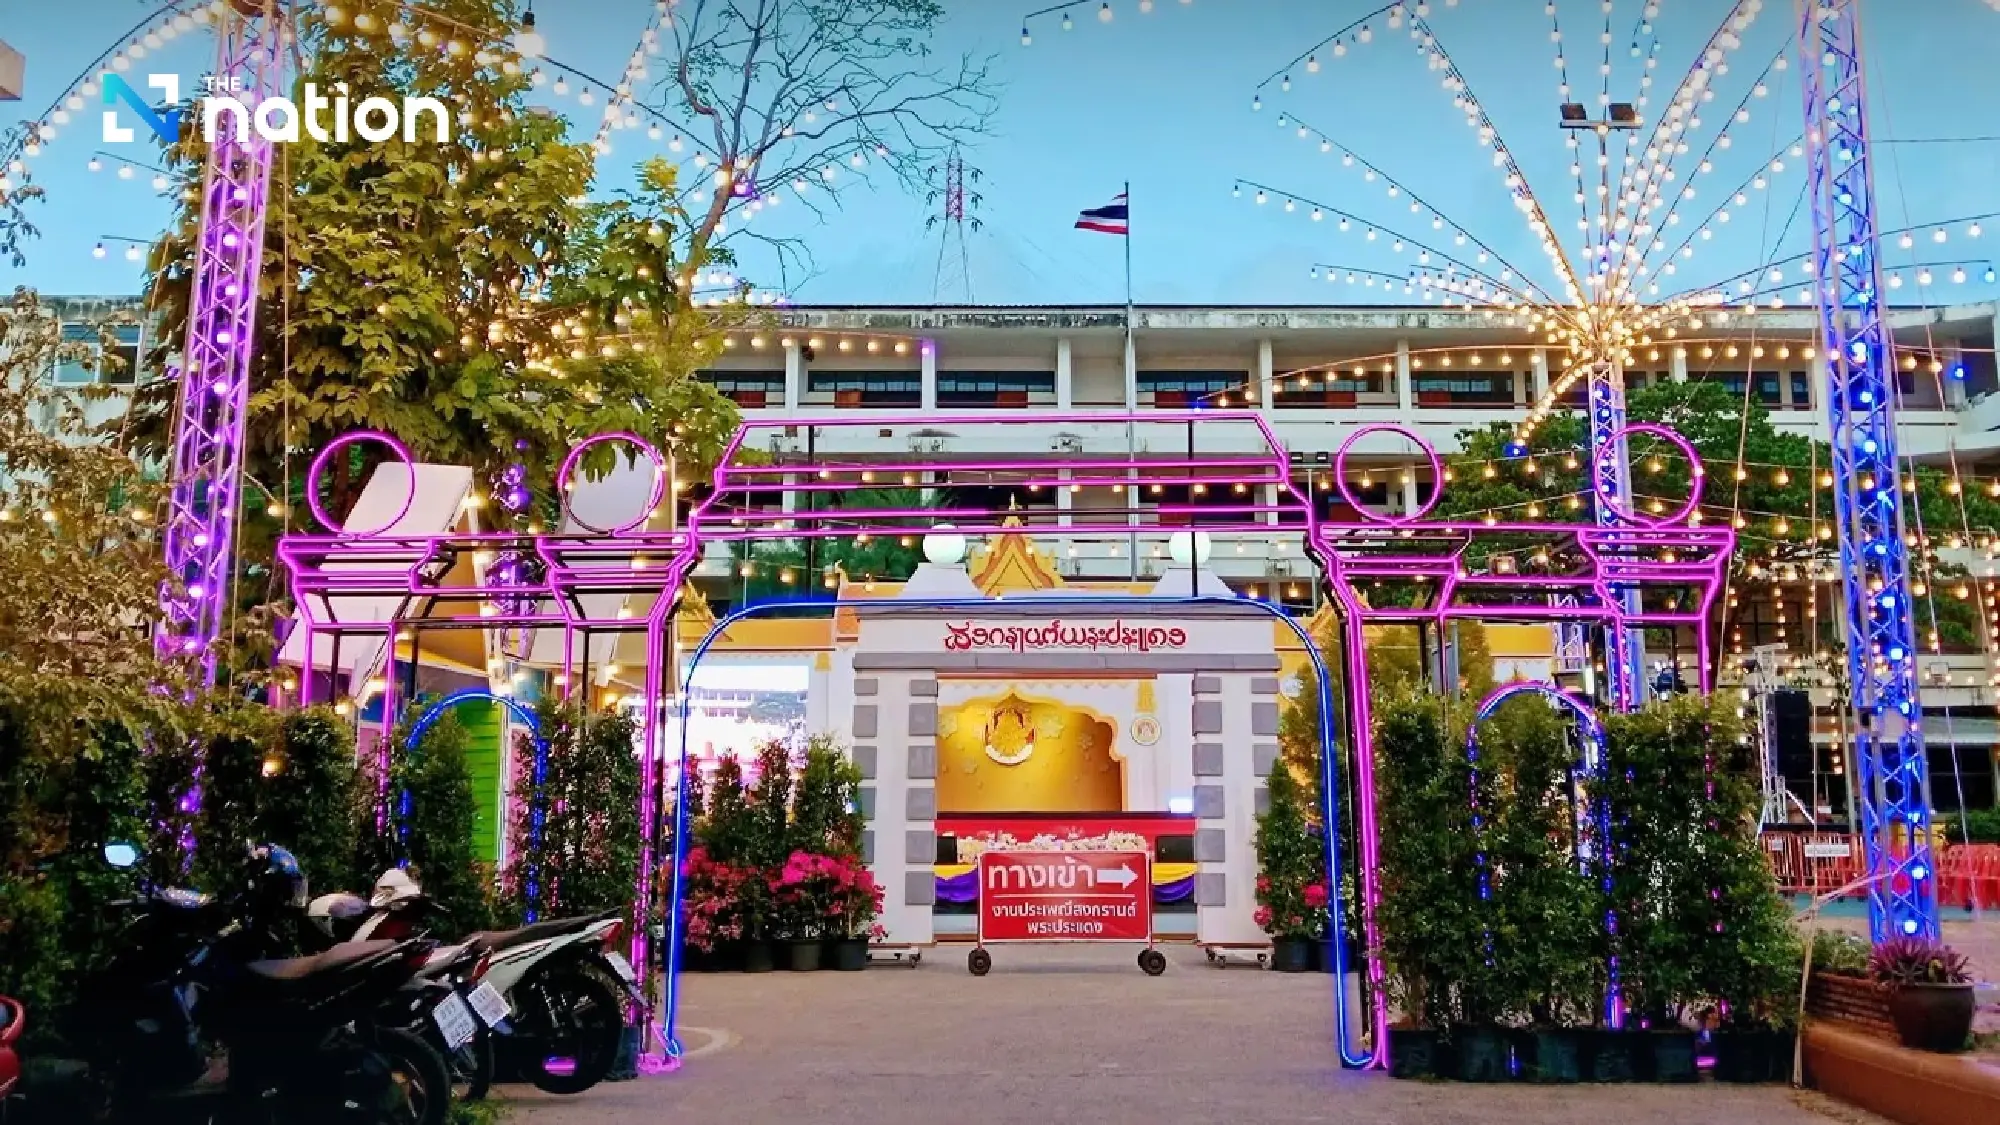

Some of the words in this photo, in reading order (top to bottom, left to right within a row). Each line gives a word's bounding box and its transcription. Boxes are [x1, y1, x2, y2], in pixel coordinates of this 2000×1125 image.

[988, 856, 1094, 889] ทางเข้า
[992, 900, 1137, 917] งานประเพณีสงกรานต์
[1027, 919, 1103, 934] พระประแดง
